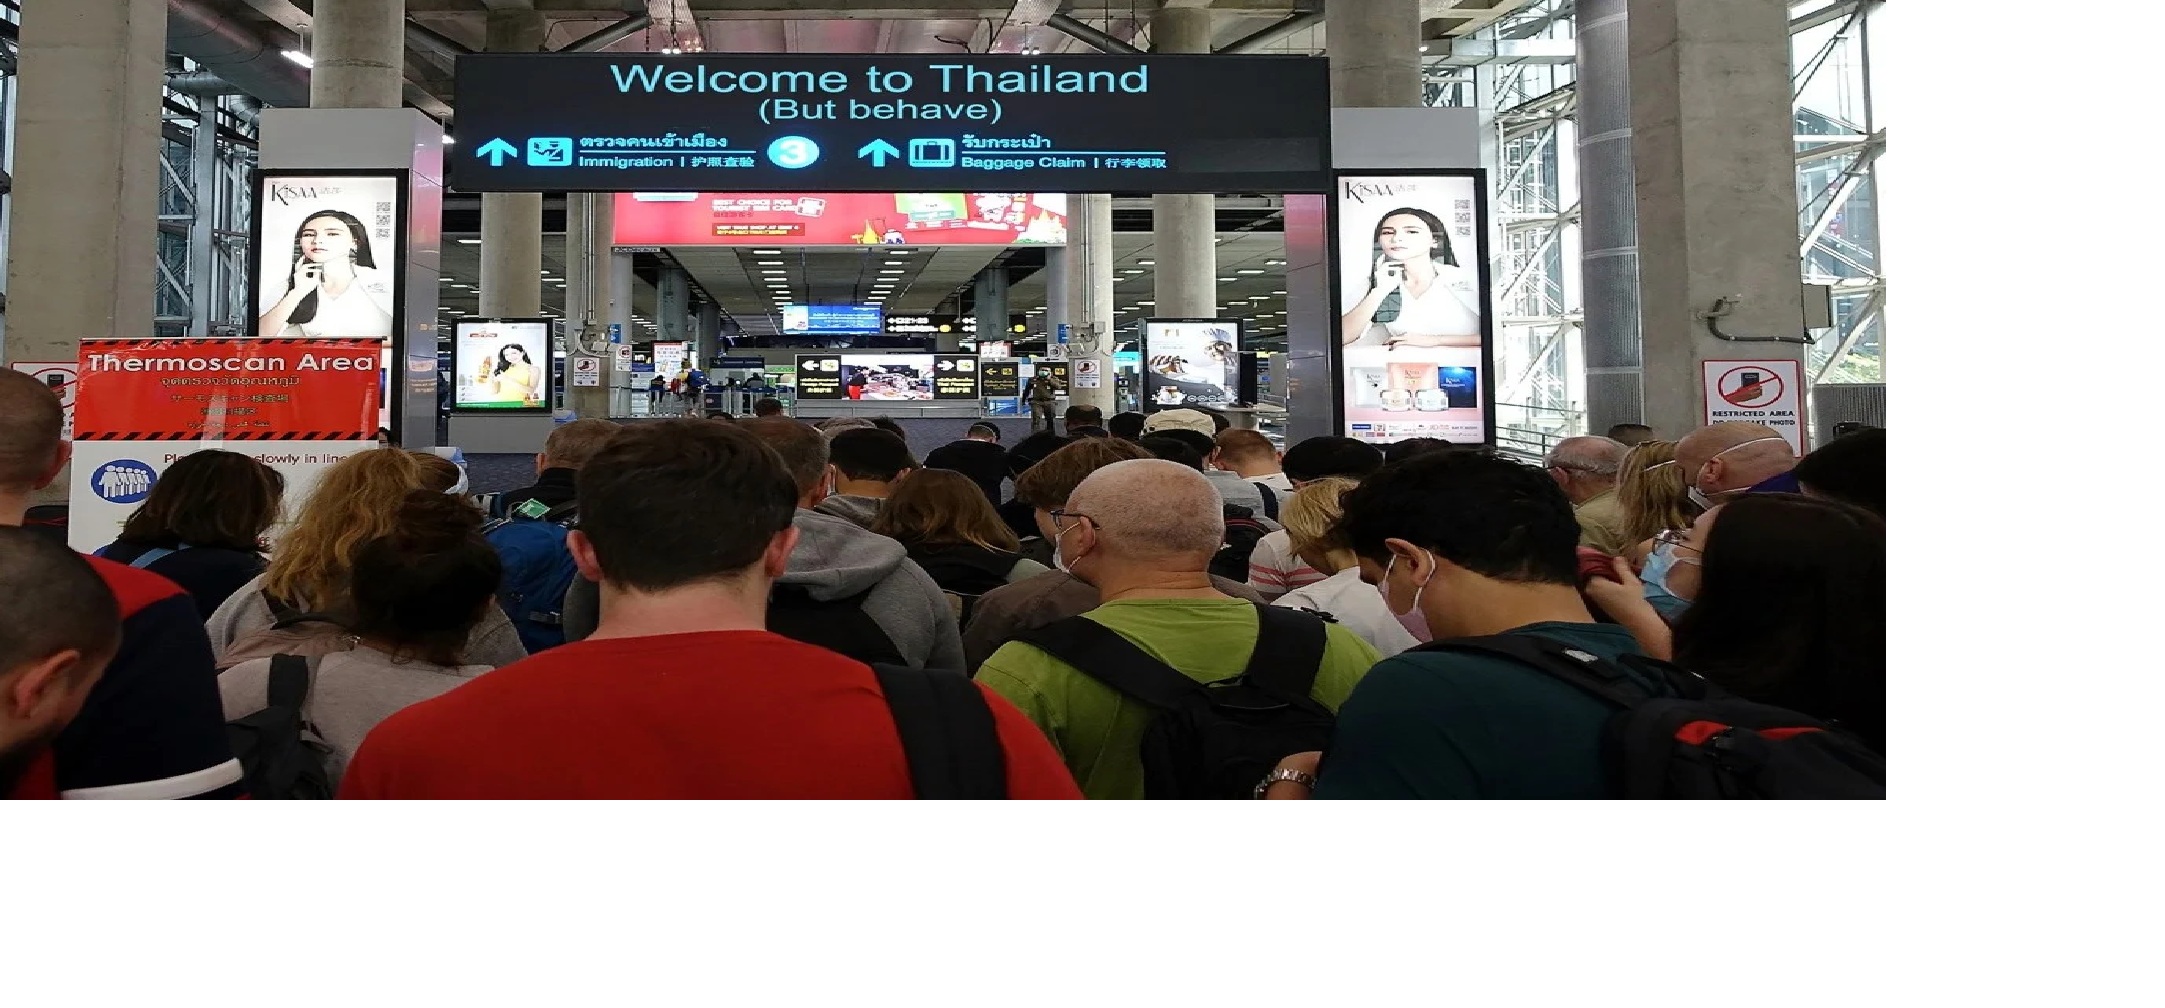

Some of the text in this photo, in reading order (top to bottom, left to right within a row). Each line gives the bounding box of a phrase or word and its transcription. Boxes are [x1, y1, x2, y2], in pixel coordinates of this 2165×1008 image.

[610, 64, 1148, 93] Welcome to Thailand
[759, 98, 1002, 124] (But behave)
[579, 132, 728, 148] ตรวจคนเข้าเมือง
[961, 133, 1051, 149] รับกระเป๋า
[779, 140, 807, 165] 3
[579, 156, 674, 170] Immigration
[961, 157, 1035, 171] Baggage
[1038, 157, 1086, 169] Claim
[88, 353, 373, 371] Thermoscan Area
[303, 453, 318, 464] in
